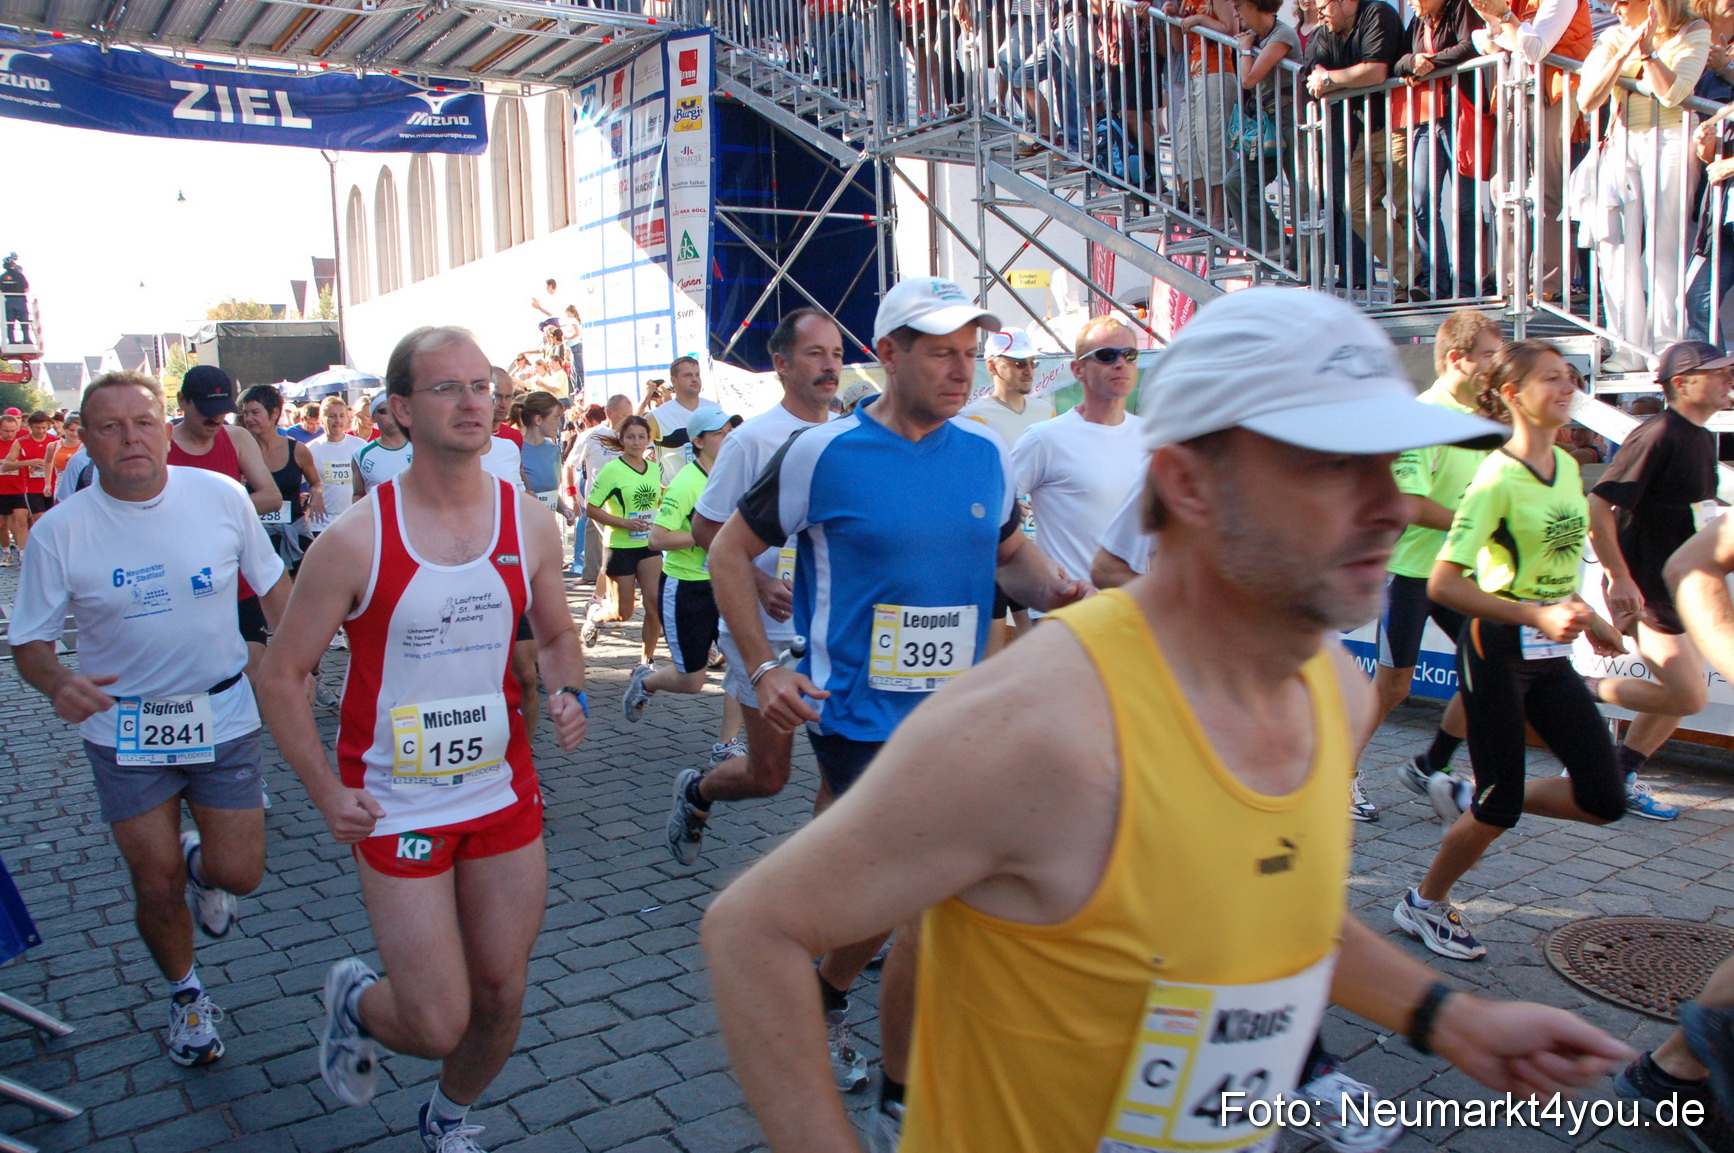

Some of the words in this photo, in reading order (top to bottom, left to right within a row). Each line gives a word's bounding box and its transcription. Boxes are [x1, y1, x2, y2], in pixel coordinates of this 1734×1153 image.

[169, 80, 312, 129] ZIEL
[455, 592, 492, 605] Lauftreff
[474, 602, 502, 611] Michael
[455, 614, 484, 623] Amberg
[903, 611, 960, 630] Leopold
[879, 634, 891, 648] C
[903, 641, 953, 667] 393
[143, 700, 194, 716] Sigfried
[423, 705, 487, 730] Michael
[124, 720, 134, 731] C
[144, 722, 204, 746] 2841
[403, 740, 415, 754] C
[429, 737, 483, 766] 155
[396, 837, 433, 860] KP
[1141, 1058, 1176, 1089] C
